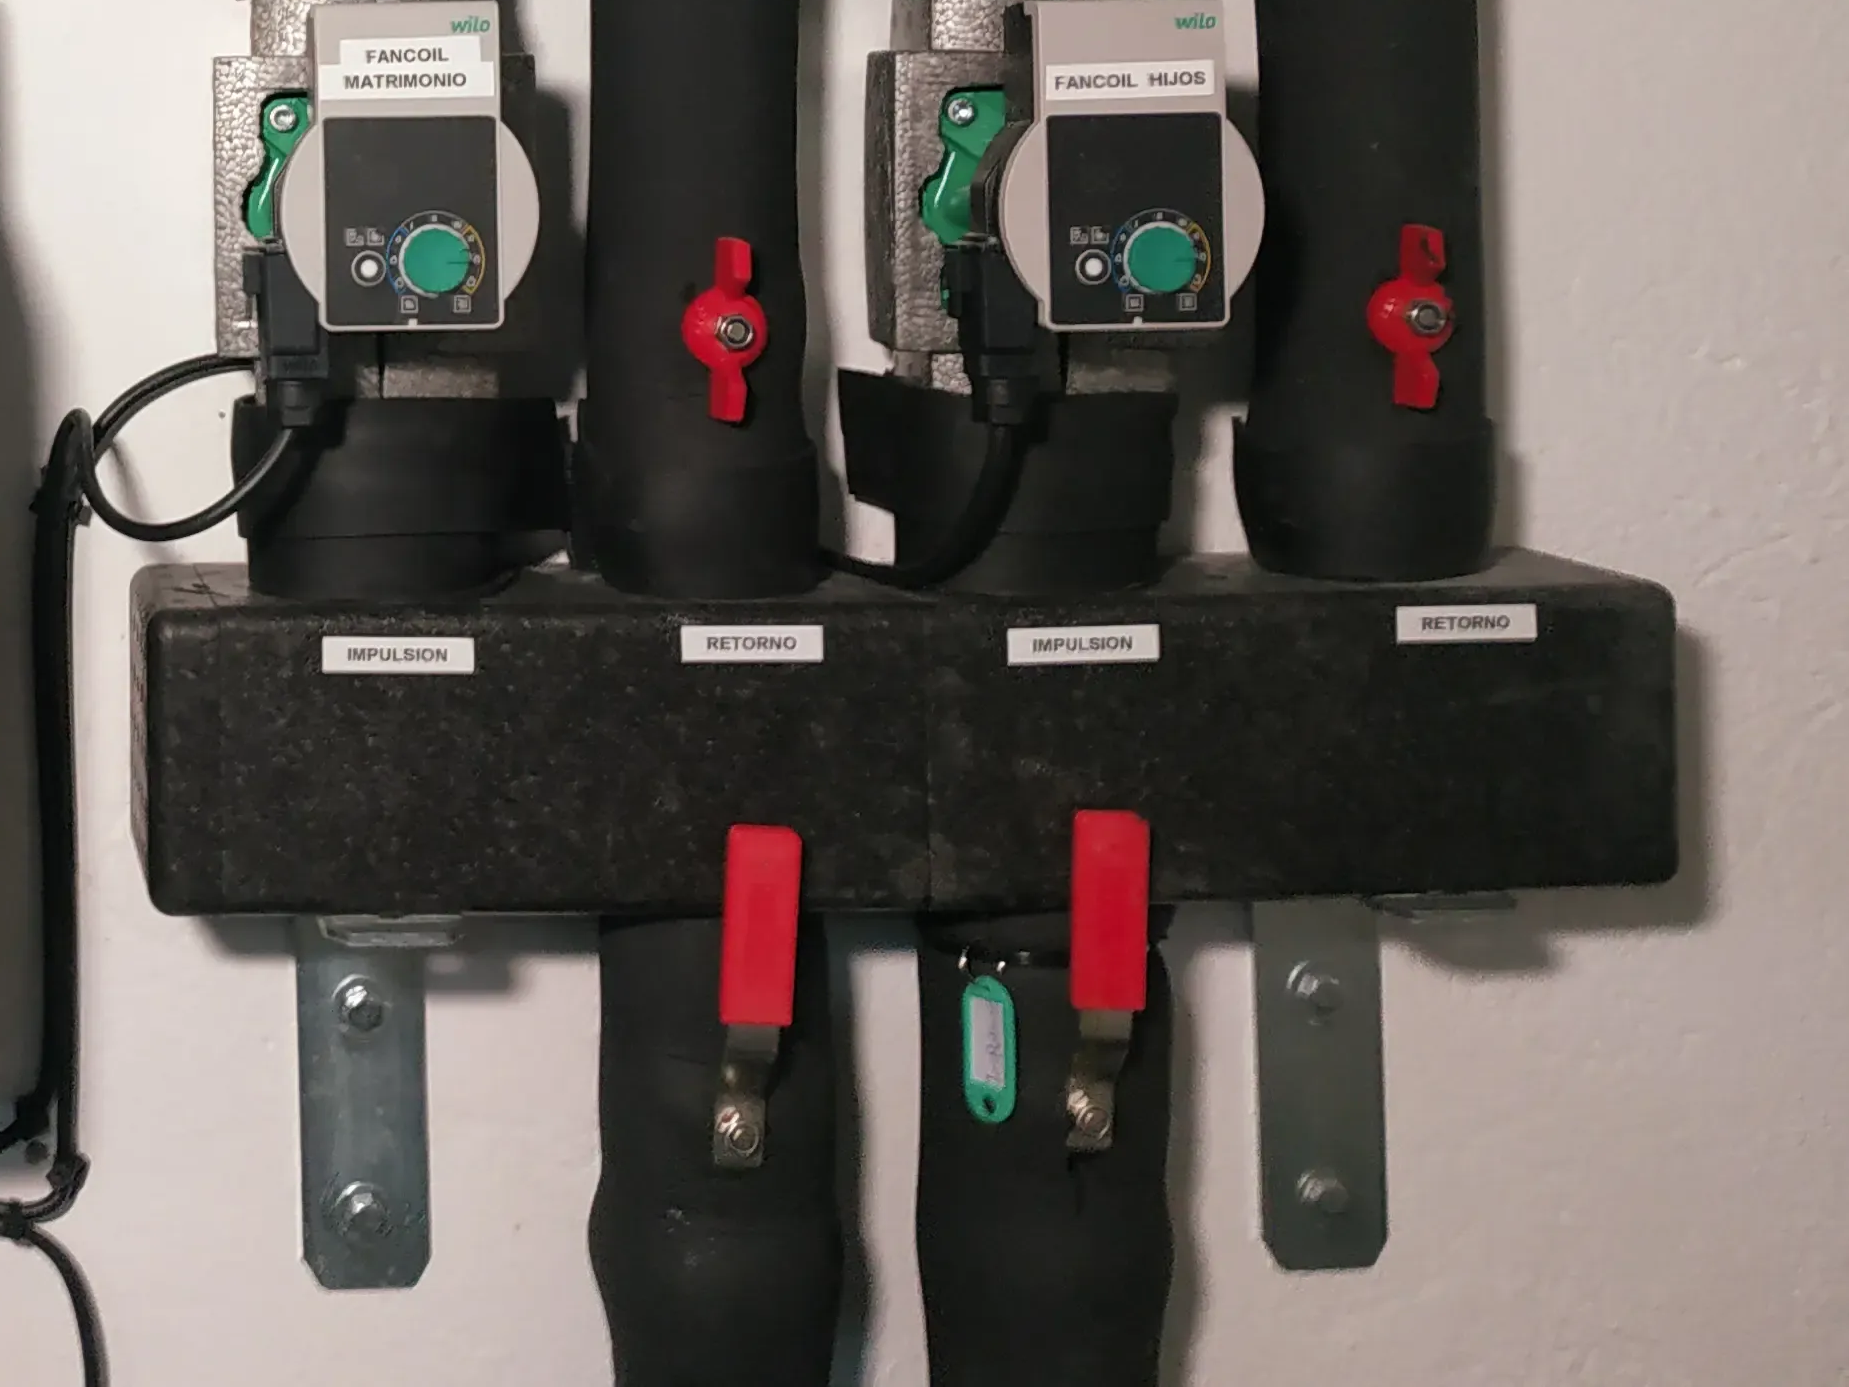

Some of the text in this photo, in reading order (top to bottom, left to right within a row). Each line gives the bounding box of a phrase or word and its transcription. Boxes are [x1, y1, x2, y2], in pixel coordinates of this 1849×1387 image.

[450, 16, 490, 33] wilo
[1175, 14, 1216, 29] wilo
[365, 48, 449, 64] FANCOIL
[344, 73, 467, 90] MATRIMONIO
[1054, 71, 1206, 90] FANCOIL HIJOS
[1421, 614, 1510, 631] RETORNO
[706, 635, 797, 651] RETORNO
[1032, 635, 1133, 653] IMPULSION
[346, 646, 448, 663] IMPULSION
